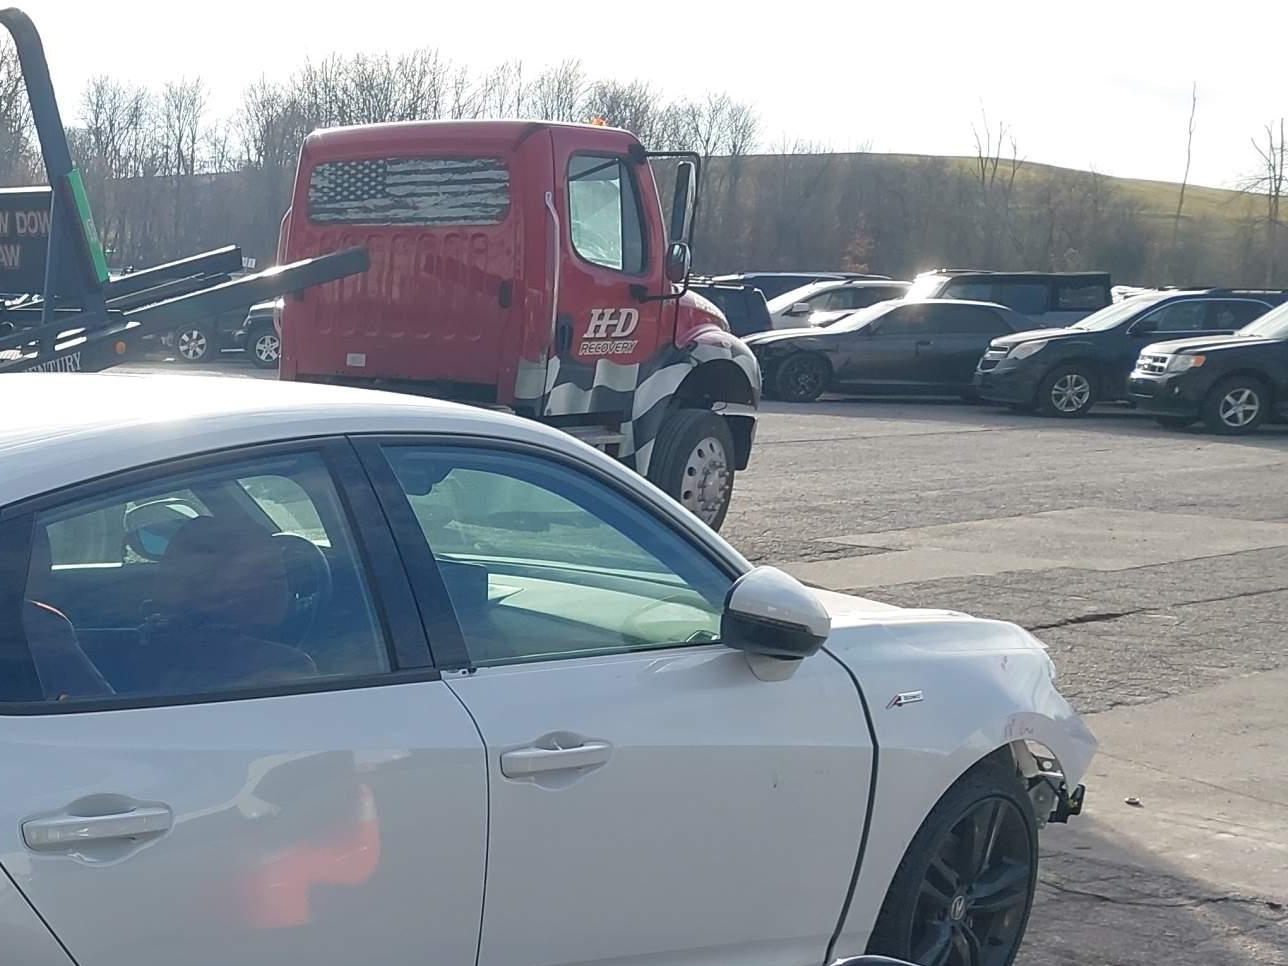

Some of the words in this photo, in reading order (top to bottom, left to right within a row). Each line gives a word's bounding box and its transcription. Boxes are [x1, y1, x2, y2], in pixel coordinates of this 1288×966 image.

[15, 210, 52, 235] DOW
[582, 308, 639, 338] H-D
[578, 340, 639, 356] RECOVERY
[24, 351, 82, 373] ENTURY
